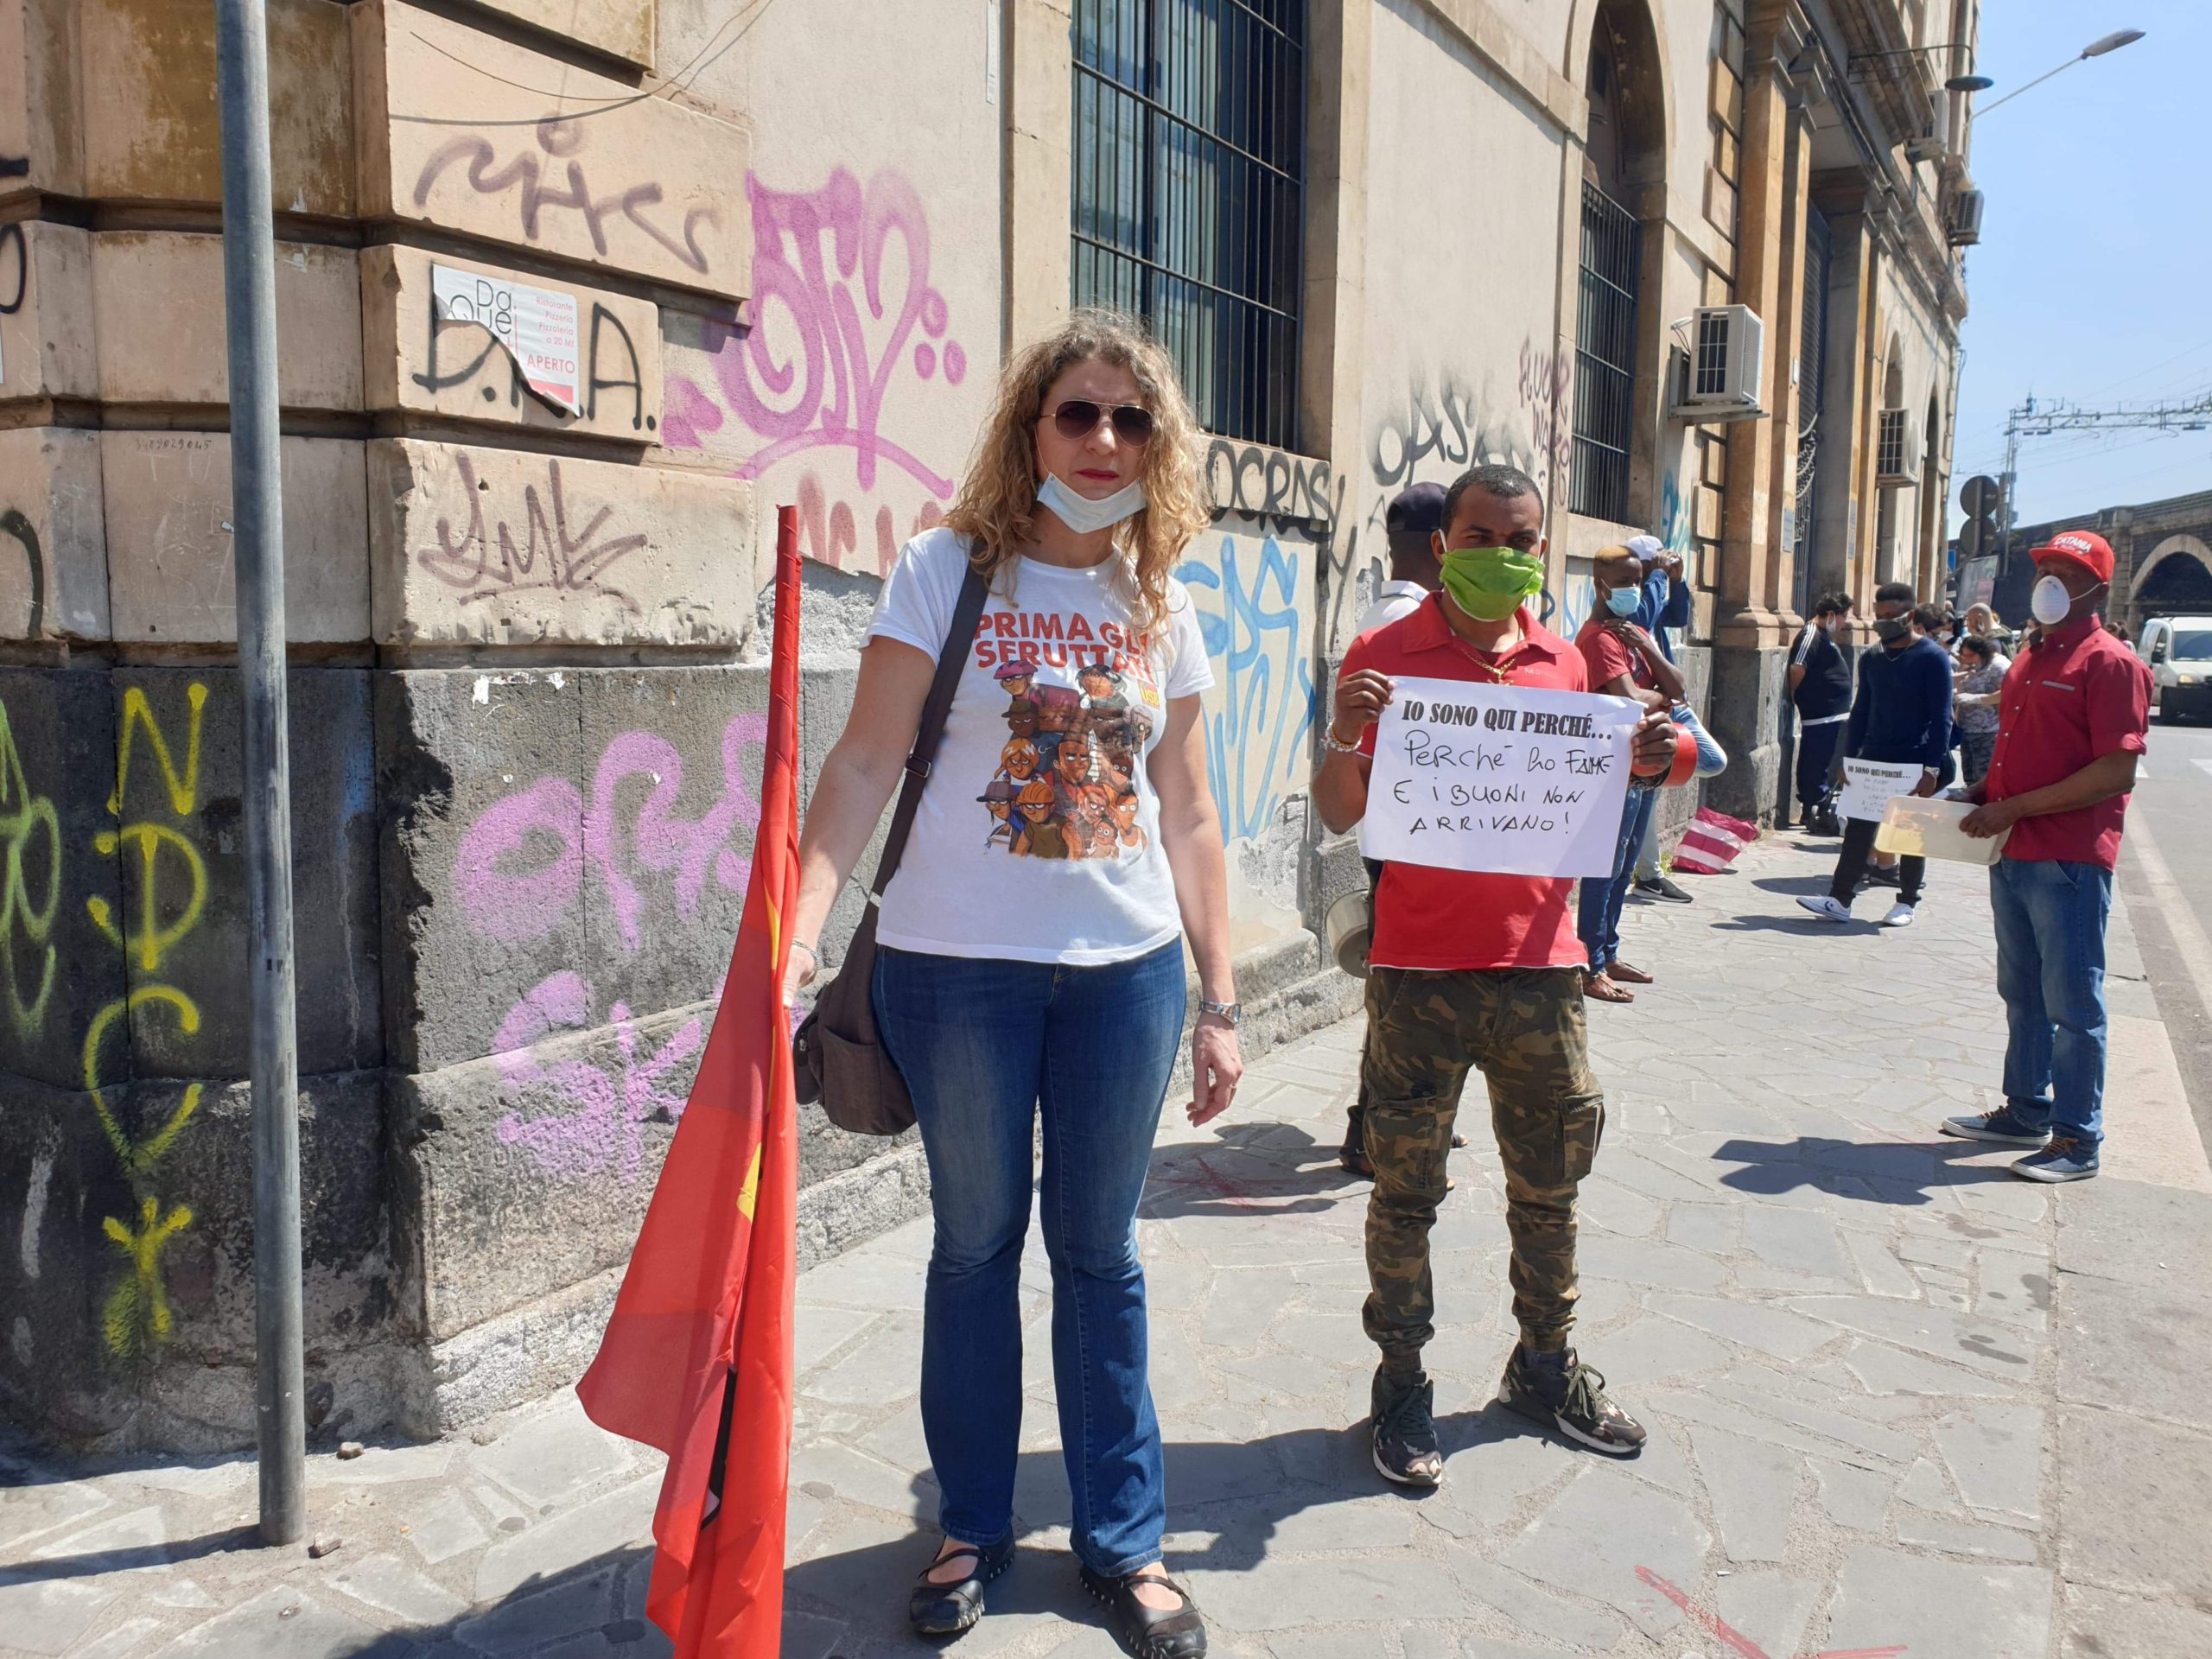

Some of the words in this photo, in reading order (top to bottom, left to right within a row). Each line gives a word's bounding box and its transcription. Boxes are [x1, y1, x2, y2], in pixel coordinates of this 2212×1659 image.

[536, 296, 574, 312] Ristorante
[545, 310, 574, 323] Pizzeria
[538, 321, 574, 336] Pizzoleria
[554, 336, 563, 346] 20
[527, 353, 575, 374] APERTO
[974, 612, 1094, 641] PRIMA
[1402, 700, 1425, 721] IO
[1429, 702, 1478, 727] SONO
[1484, 708, 1517, 731] QUI
[1521, 711, 1612, 740] PERCHÉ...
[1855, 766, 1870, 775] SONO
[1394, 779, 1413, 804] E
[1451, 784, 1525, 806] BUONI
[1542, 785, 1585, 804] NON
